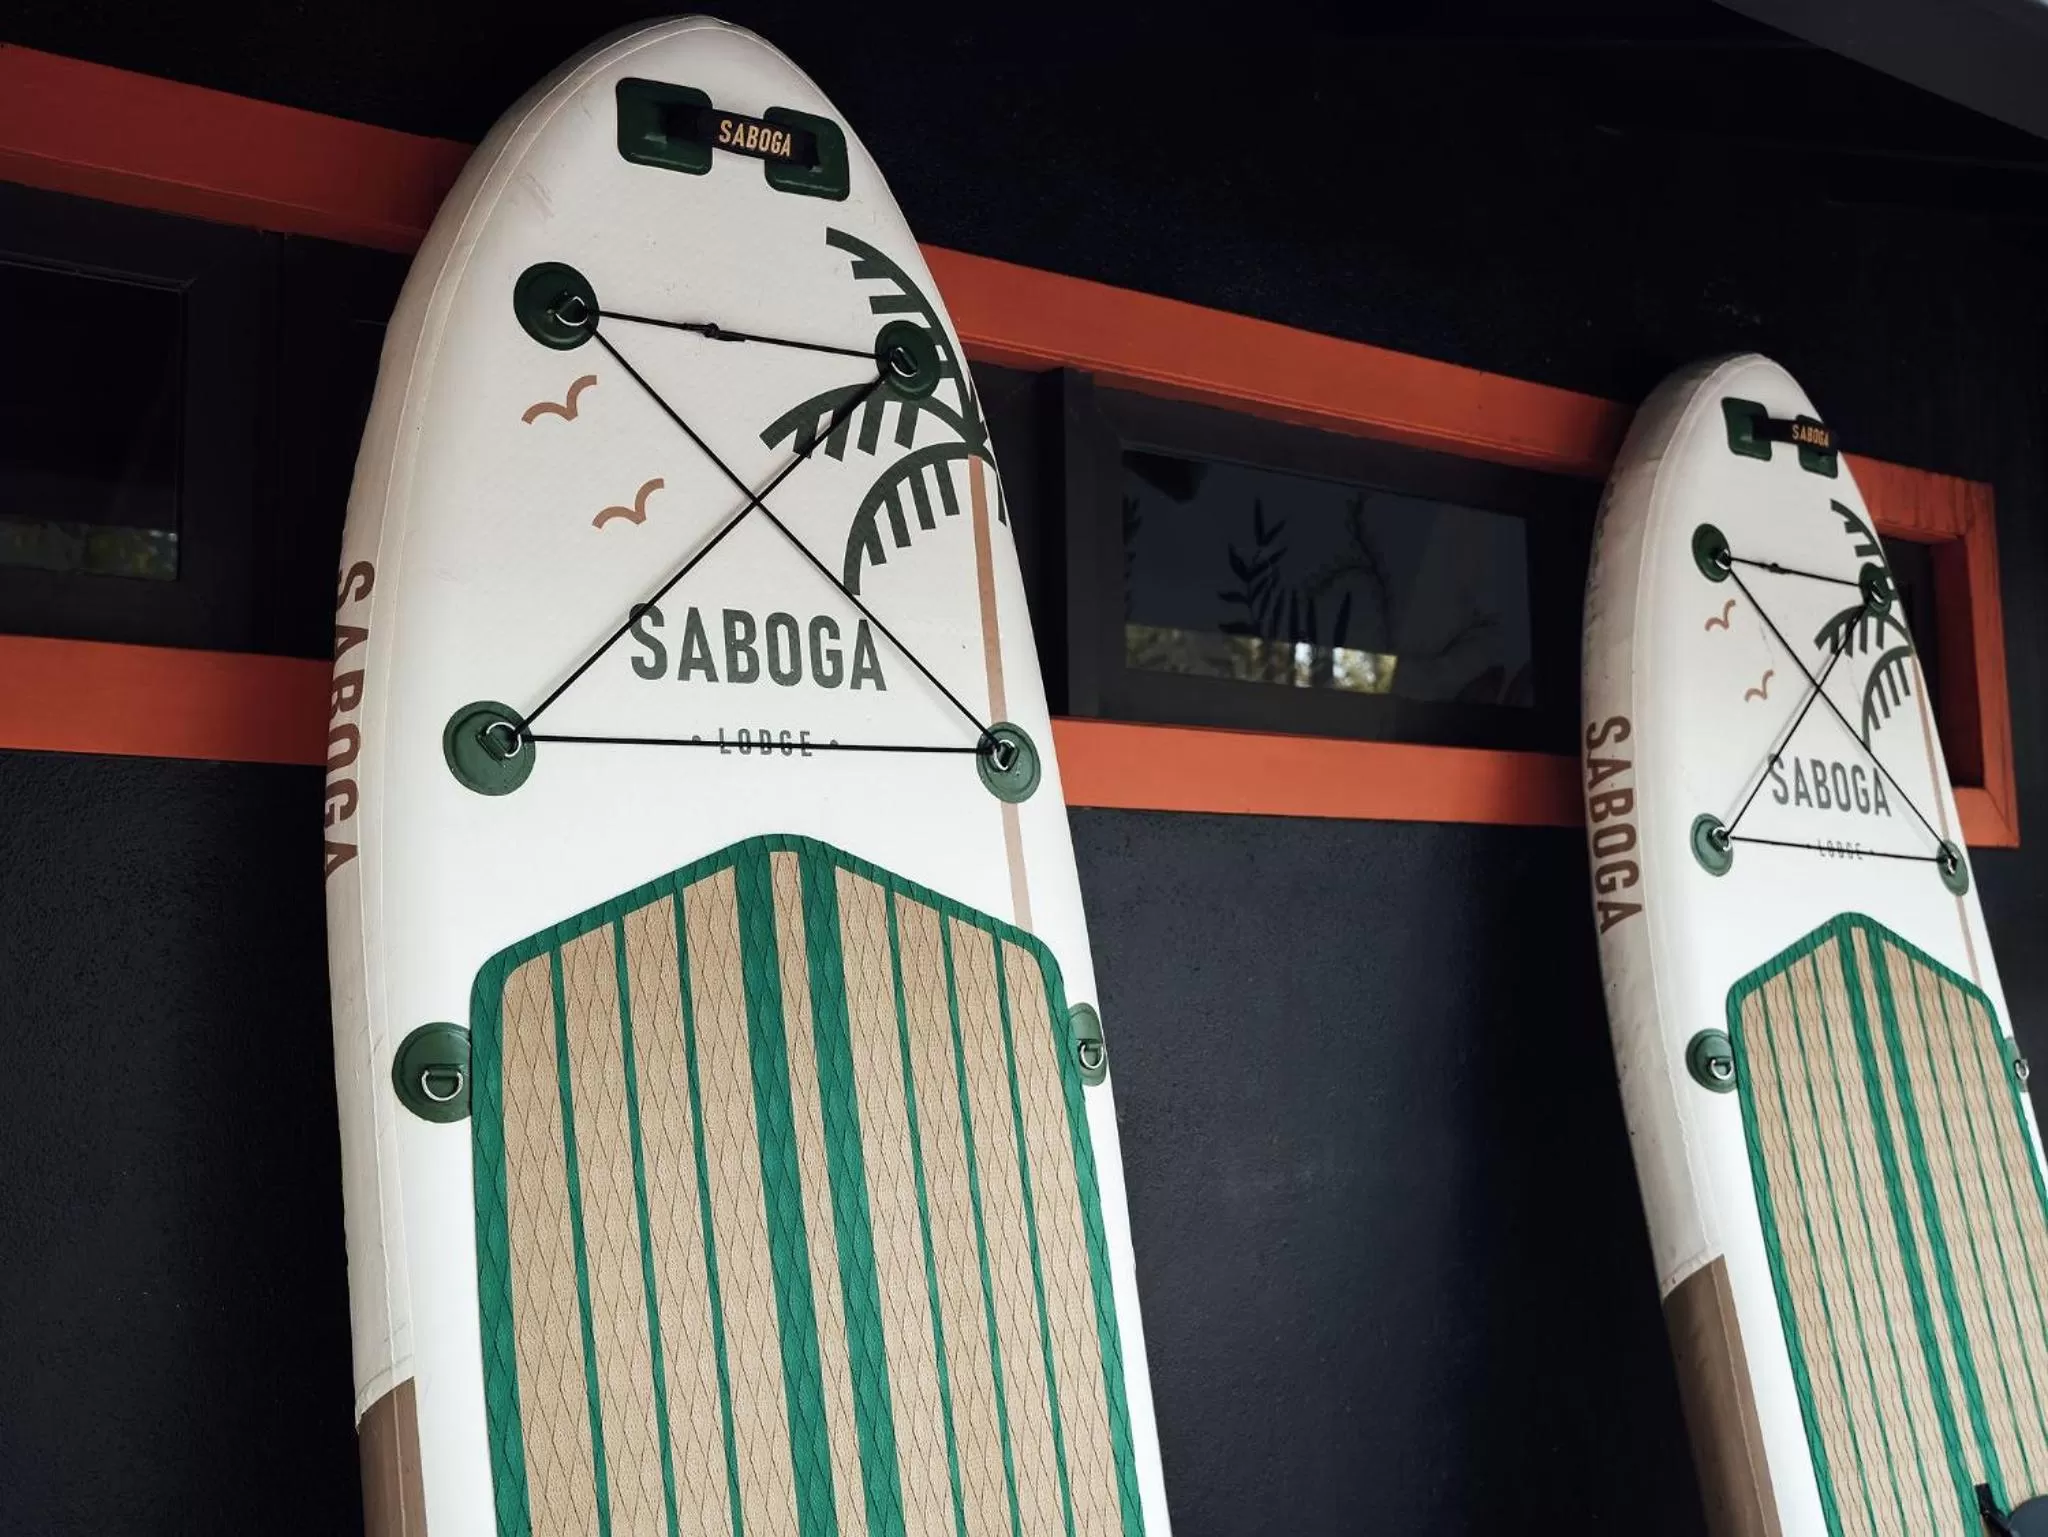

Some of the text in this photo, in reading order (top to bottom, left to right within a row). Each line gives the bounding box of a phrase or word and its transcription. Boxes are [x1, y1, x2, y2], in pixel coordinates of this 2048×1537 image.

[718, 119, 792, 157] SABOGA
[1792, 424, 1829, 448] SABOGA
[629, 603, 887, 691] SABOGA
[719, 727, 813, 757] LODGE
[1767, 753, 1892, 817] SABOGA
[1586, 716, 1643, 935] SABOGA
